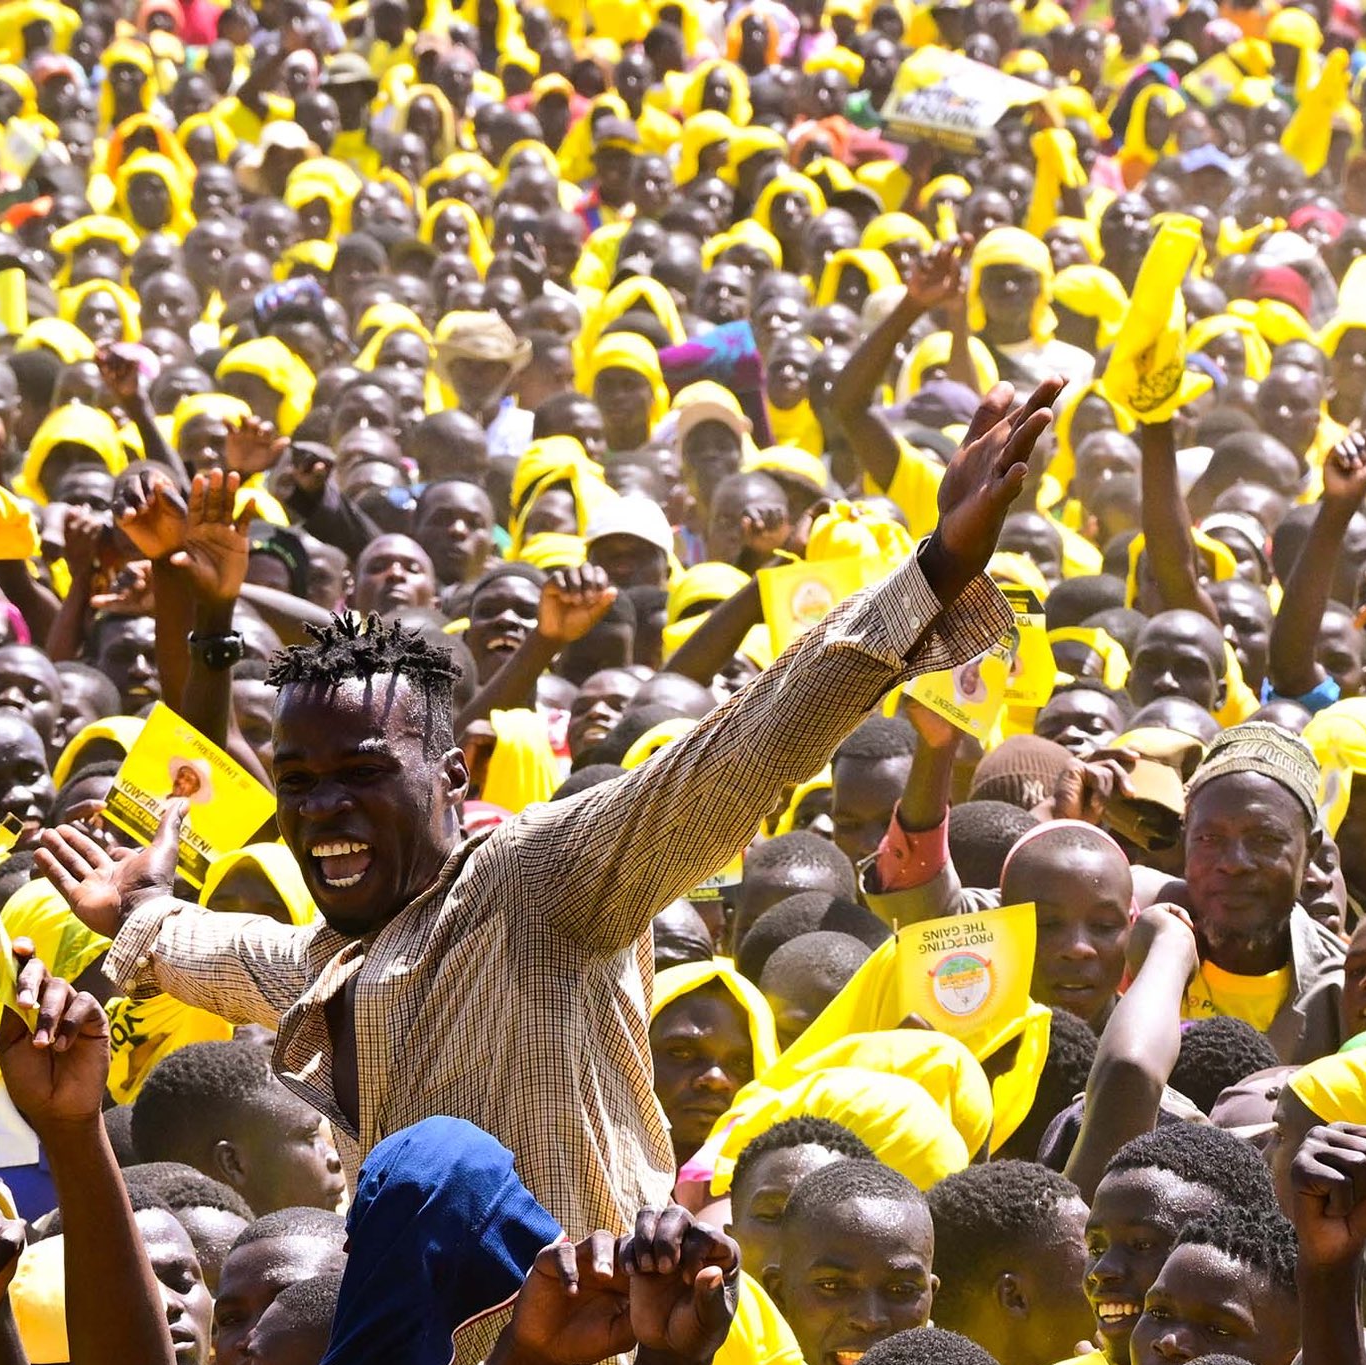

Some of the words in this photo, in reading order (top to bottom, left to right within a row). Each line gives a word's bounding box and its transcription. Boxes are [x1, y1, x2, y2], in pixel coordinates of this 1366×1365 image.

[922, 924, 957, 943] GAINS
[959, 921, 987, 935] THE
[918, 931, 995, 955] PROTECTING
